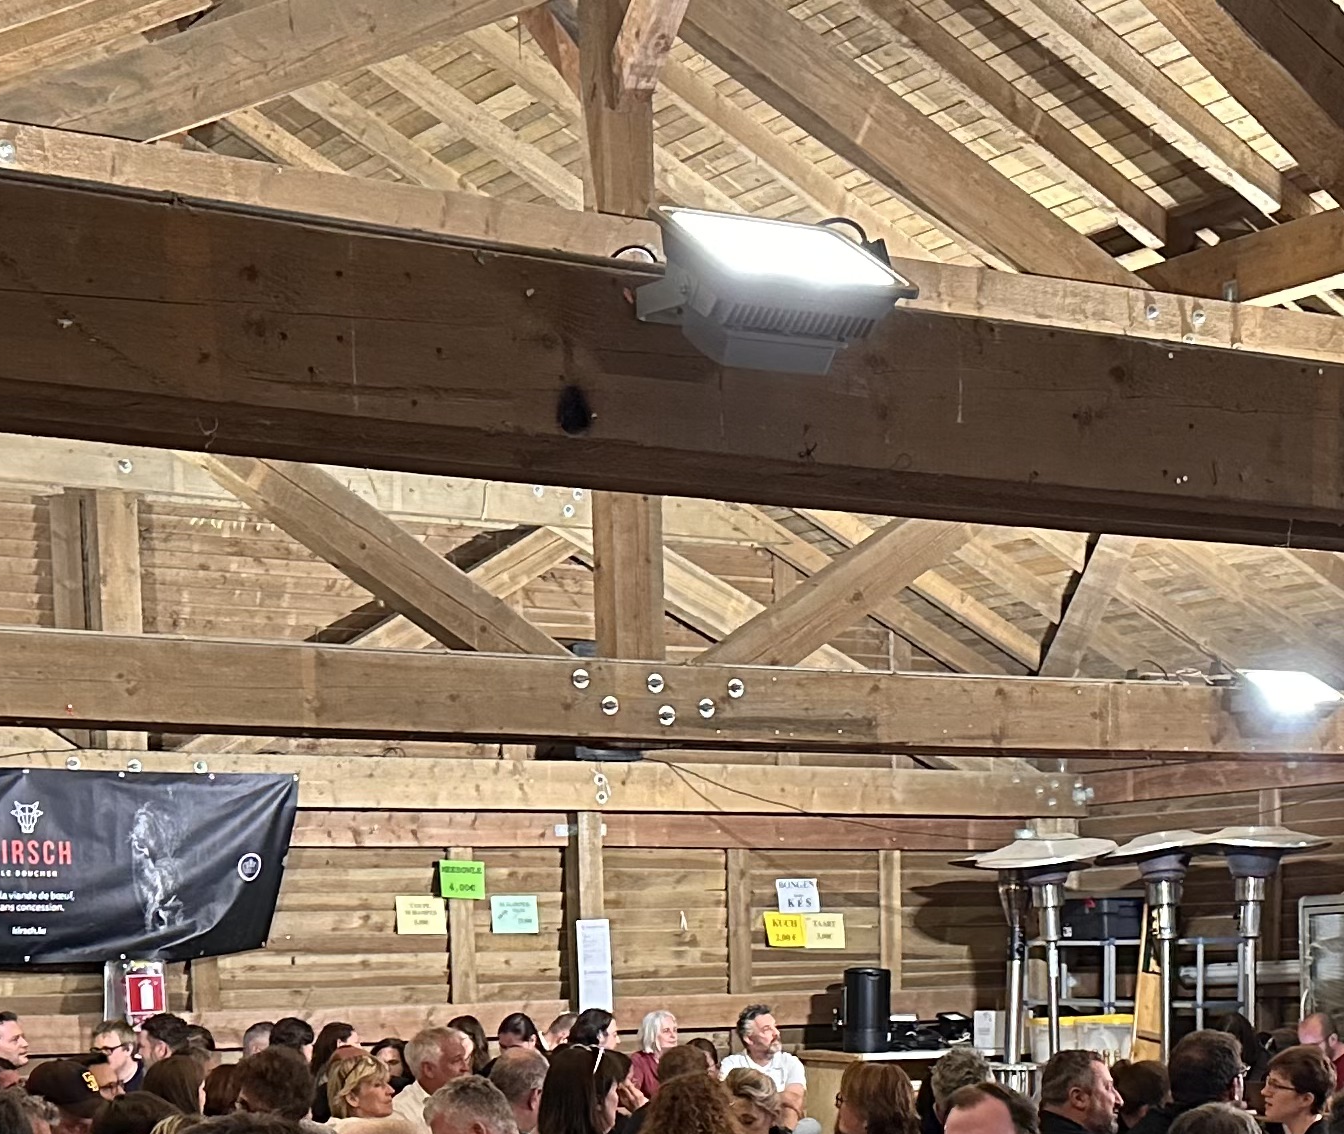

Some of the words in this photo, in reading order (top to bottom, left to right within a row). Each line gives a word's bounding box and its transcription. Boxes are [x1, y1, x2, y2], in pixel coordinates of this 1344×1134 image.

[0, 890, 8, 901] la
[8, 891, 37, 901] viande
[38, 891, 49, 901] de
